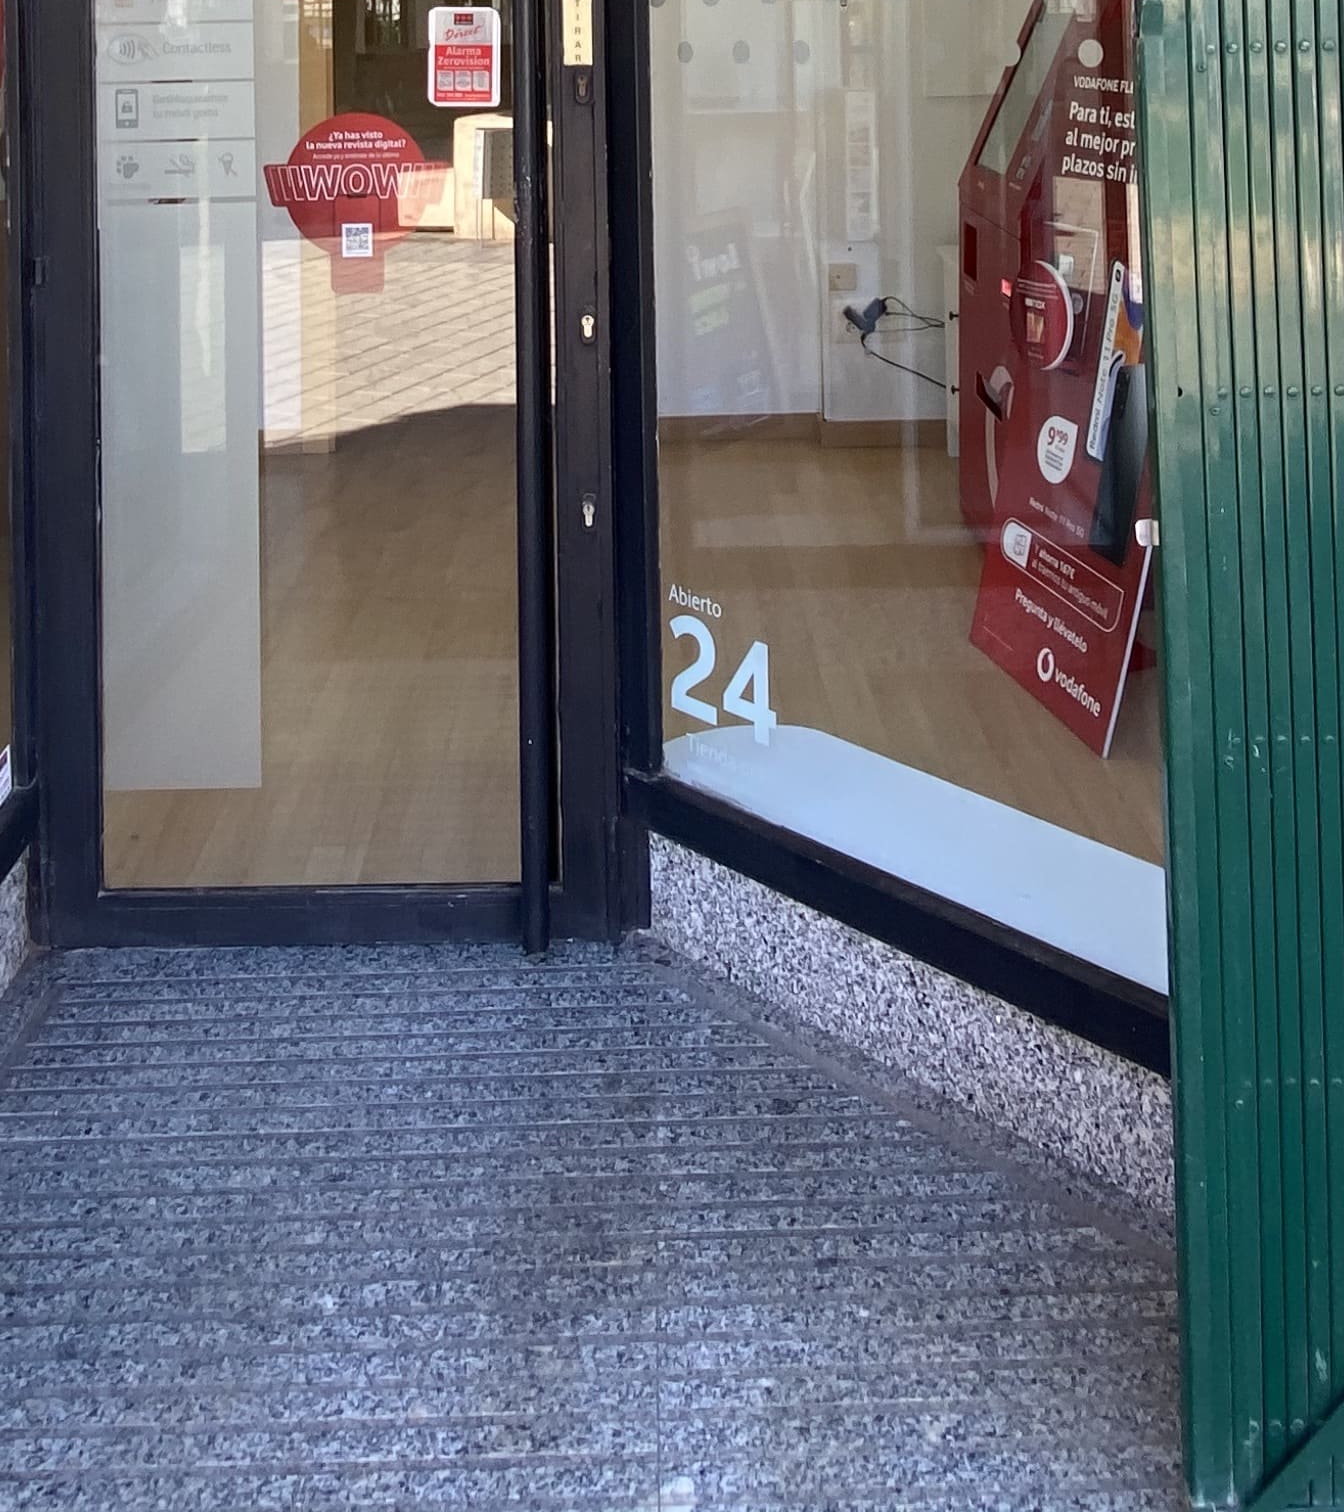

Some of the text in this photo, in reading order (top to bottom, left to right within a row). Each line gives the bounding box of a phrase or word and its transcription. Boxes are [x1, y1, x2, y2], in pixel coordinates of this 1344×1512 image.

[574, 0, 582, 62] TIRAR
[438, 56, 490, 66] Zerovision
[446, 46, 482, 56] Alarma
[1073, 75, 1119, 92] VODAFONE
[1069, 101, 1097, 123] Para
[1099, 106, 1113, 128] ti,
[306, 139, 406, 150] la nueva revista digital?
[328, 131, 383, 142] ¿Ya has visto
[1065, 128, 1079, 146] al
[1080, 132, 1120, 156] mejor
[302, 163, 412, 201] WOW
[1061, 153, 1105, 178] plazos
[1106, 161, 1128, 183] sin
[1096, 369, 1108, 405] Note
[669, 584, 723, 618] Abierto
[1015, 588, 1047, 624] Pregunta
[1046, 616, 1054, 629] y
[669, 614, 777, 747] 24
[1055, 666, 1101, 717] vodafone
